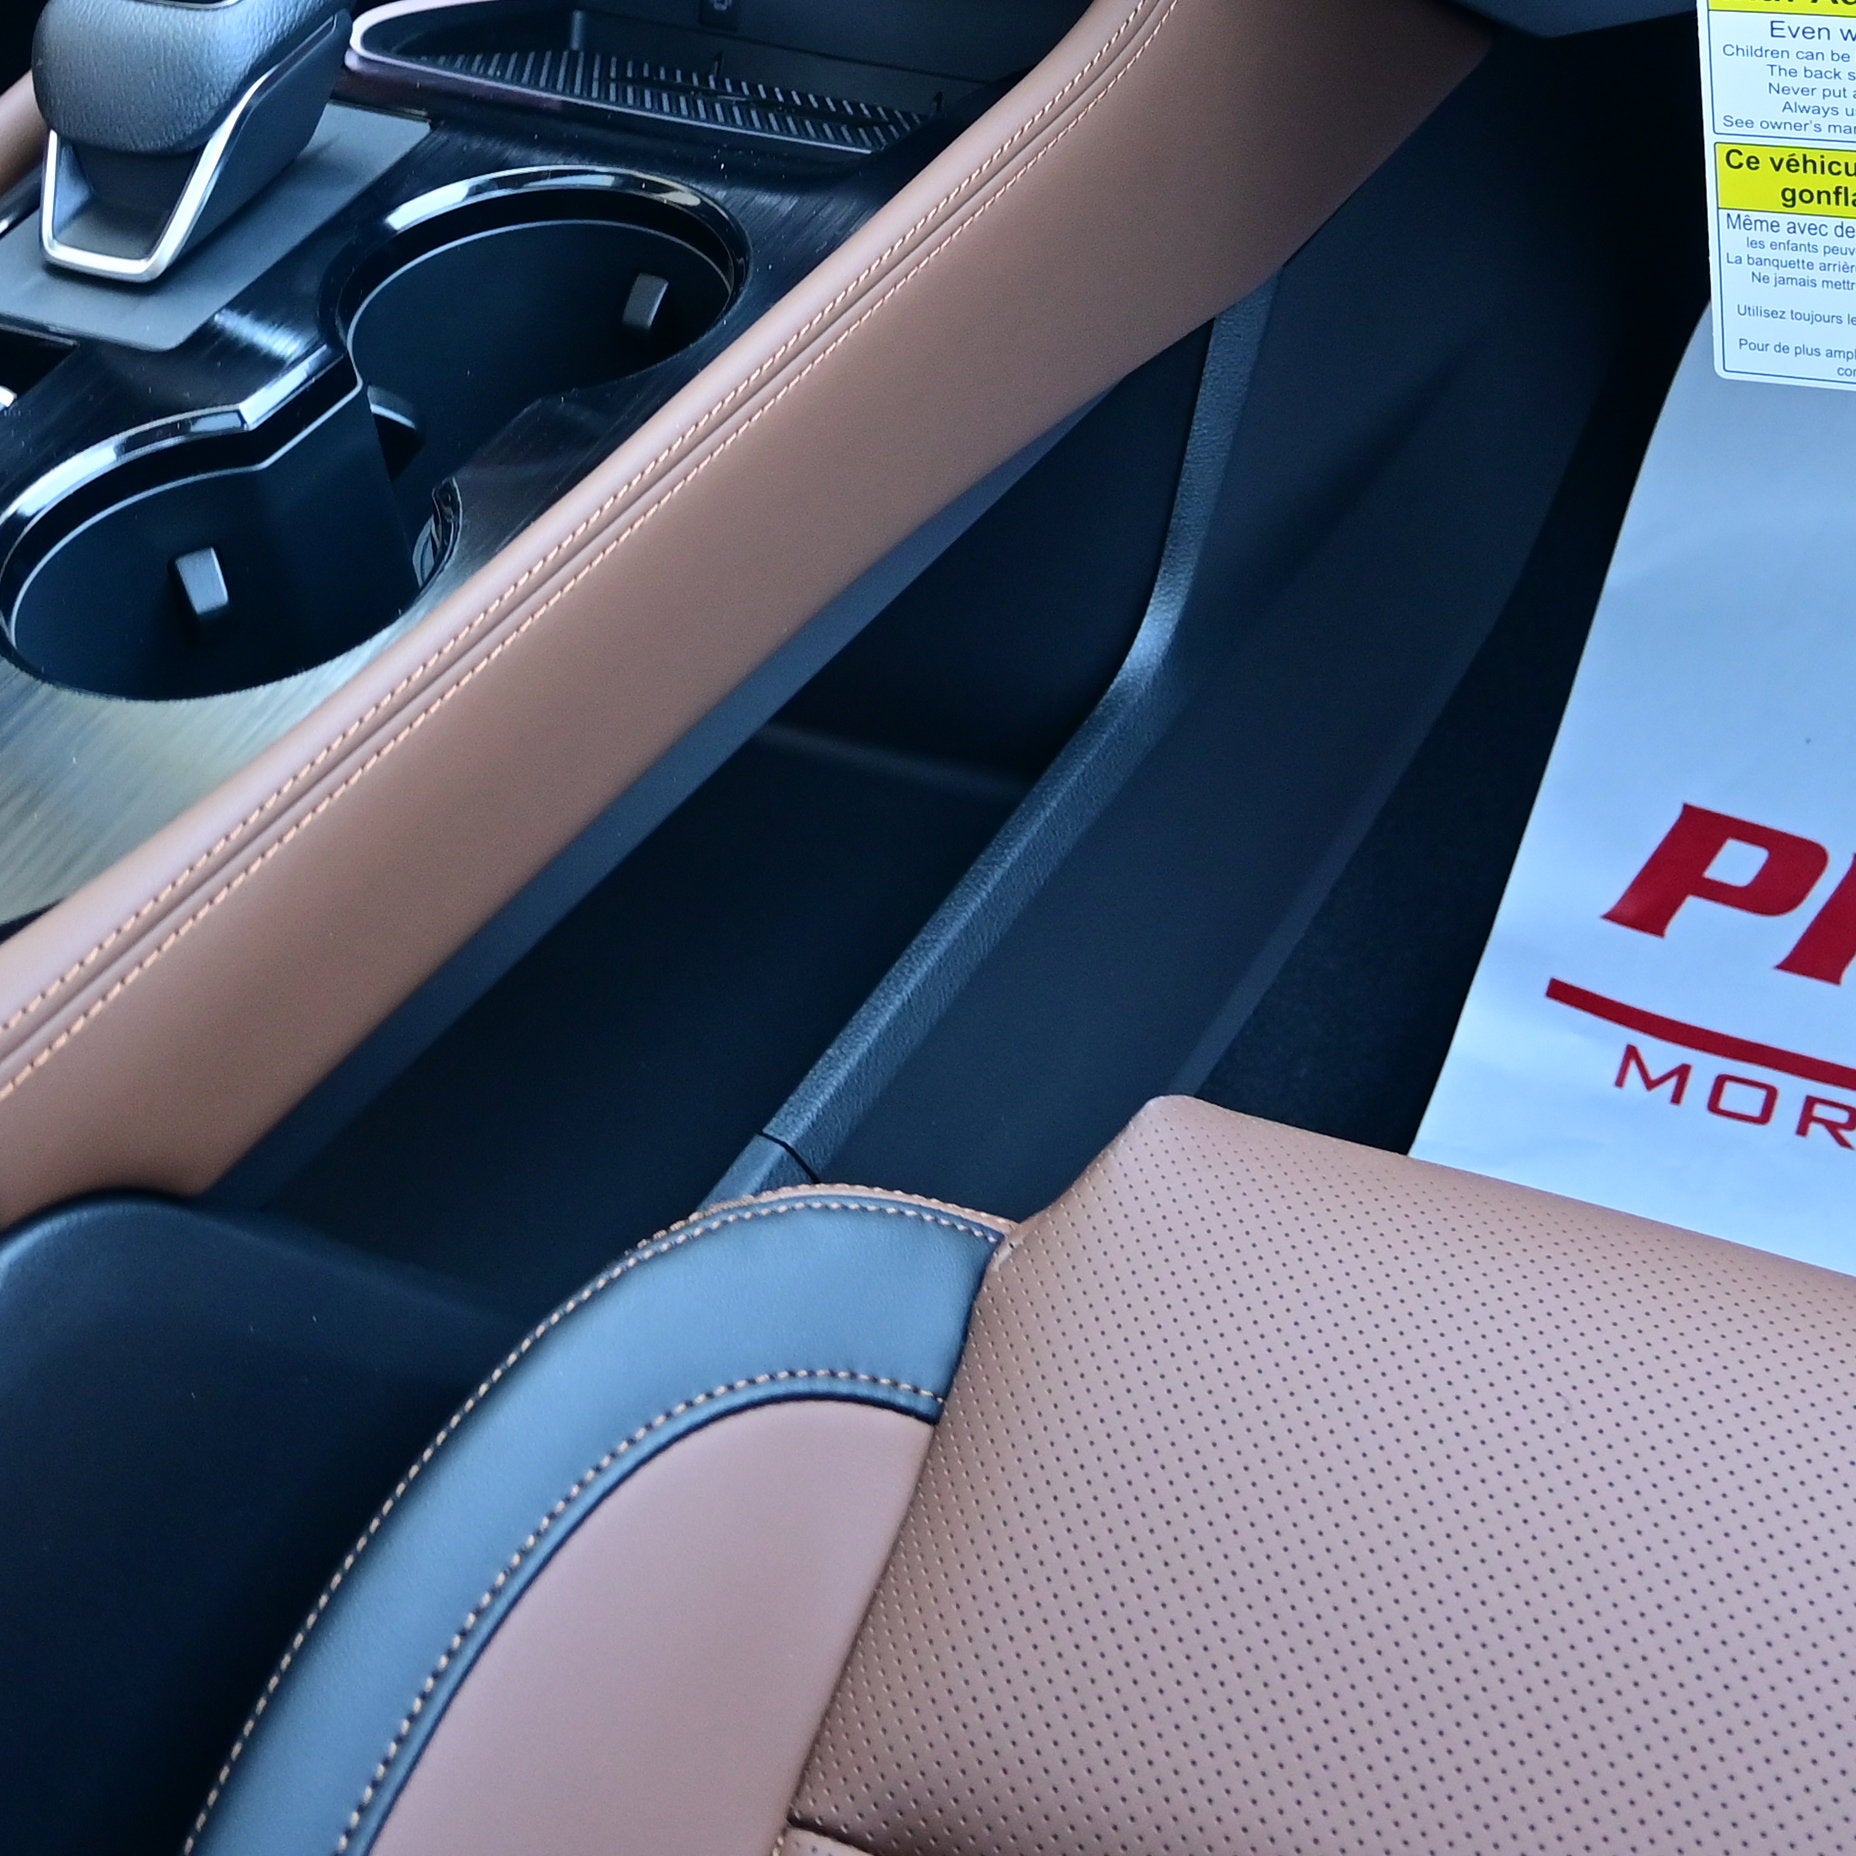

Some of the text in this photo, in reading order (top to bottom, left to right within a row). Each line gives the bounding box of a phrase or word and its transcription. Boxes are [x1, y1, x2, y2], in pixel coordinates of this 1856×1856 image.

[1770, 20, 1830, 40] Even
[1722, 44, 1790, 59] Children
[1795, 51, 1825, 61] can
[1831, 50, 1850, 63] be
[1766, 64, 1798, 77] The
[1804, 66, 1842, 80] back
[1768, 82, 1817, 96] Never
[1822, 86, 1847, 100] put
[1782, 100, 1839, 117] Always
[1723, 114, 1754, 128] See
[1760, 119, 1822, 132] owner's
[1725, 150, 1760, 171] Ce
[1726, 213, 1780, 233] Même
[1786, 221, 1828, 236] avec
[1746, 236, 1766, 249] les
[1769, 239, 1819, 253] enfants
